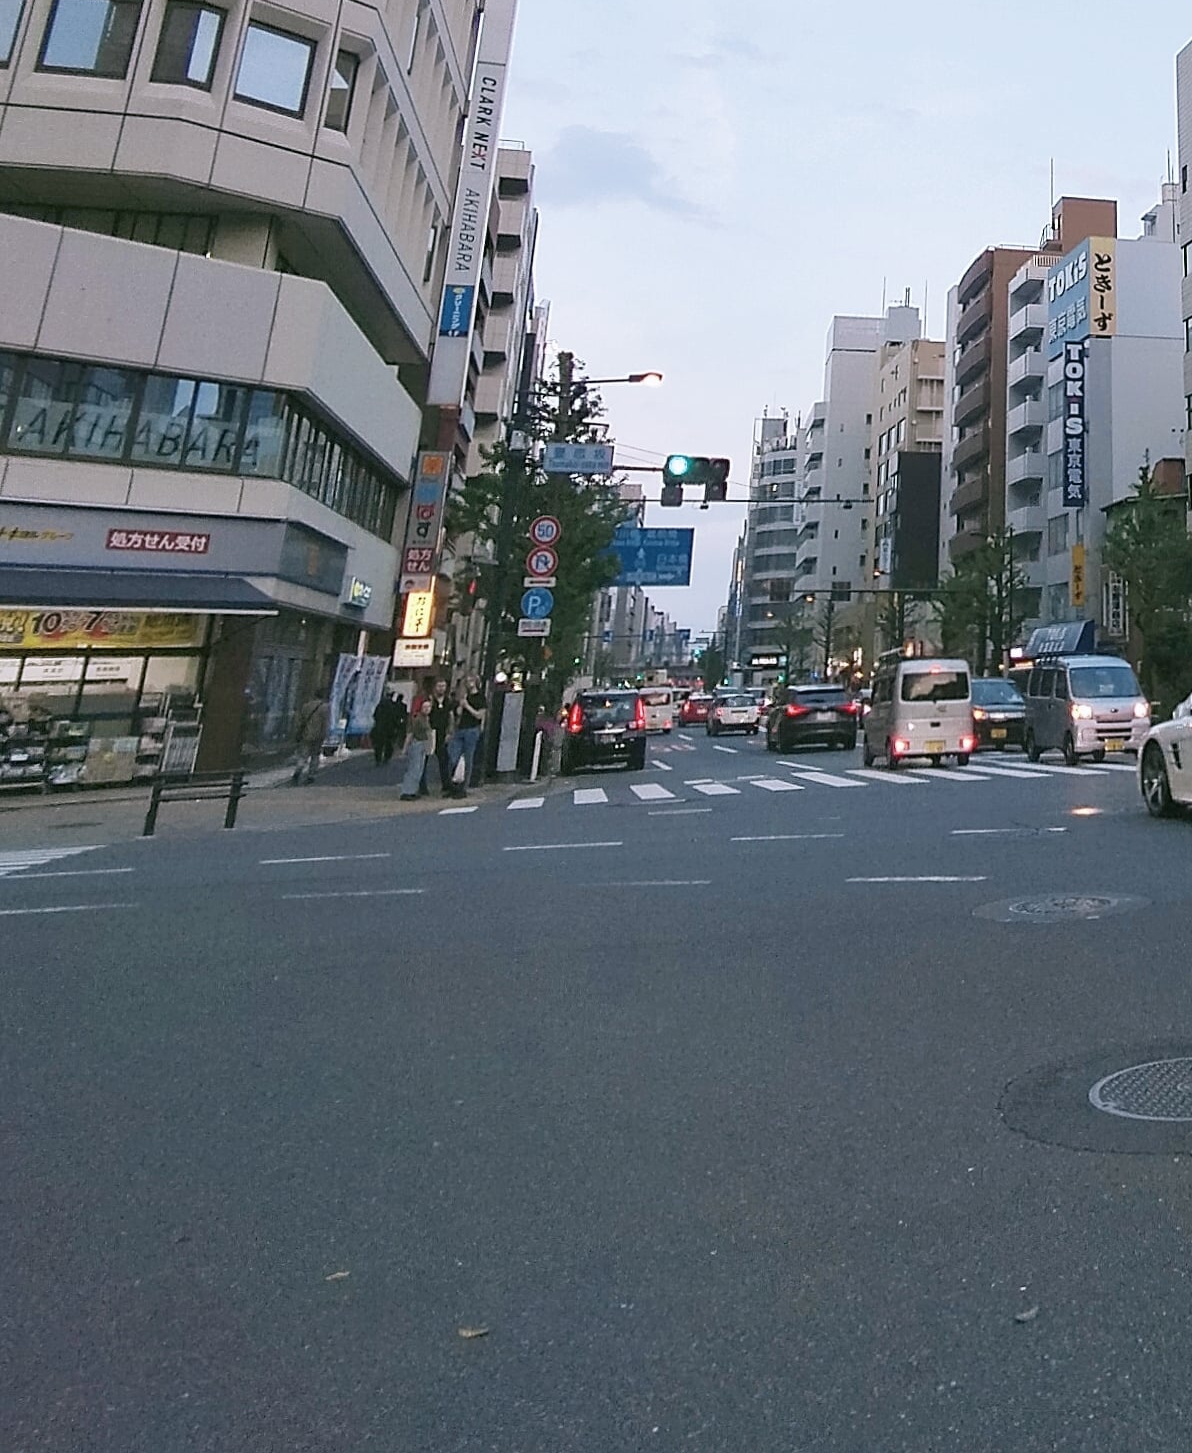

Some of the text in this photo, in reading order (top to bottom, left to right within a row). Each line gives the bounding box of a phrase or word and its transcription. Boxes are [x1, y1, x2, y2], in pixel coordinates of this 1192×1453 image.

[475, 75, 497, 126] CLARK
[469, 131, 489, 171] NEXT
[453, 187, 480, 272] AKIHABARA
[1094, 253, 1113, 331] ときーず
[1048, 296, 1088, 344] 東京電気
[17, 406, 260, 466] AKIHABARA
[1067, 437, 1083, 499] 東京電気
[110, 531, 207, 552] 処方せん受付
[537, 524, 554, 539] 50
[407, 548, 433, 561] 処方
[407, 561, 431, 573] せん
[528, 596, 541, 615] P
